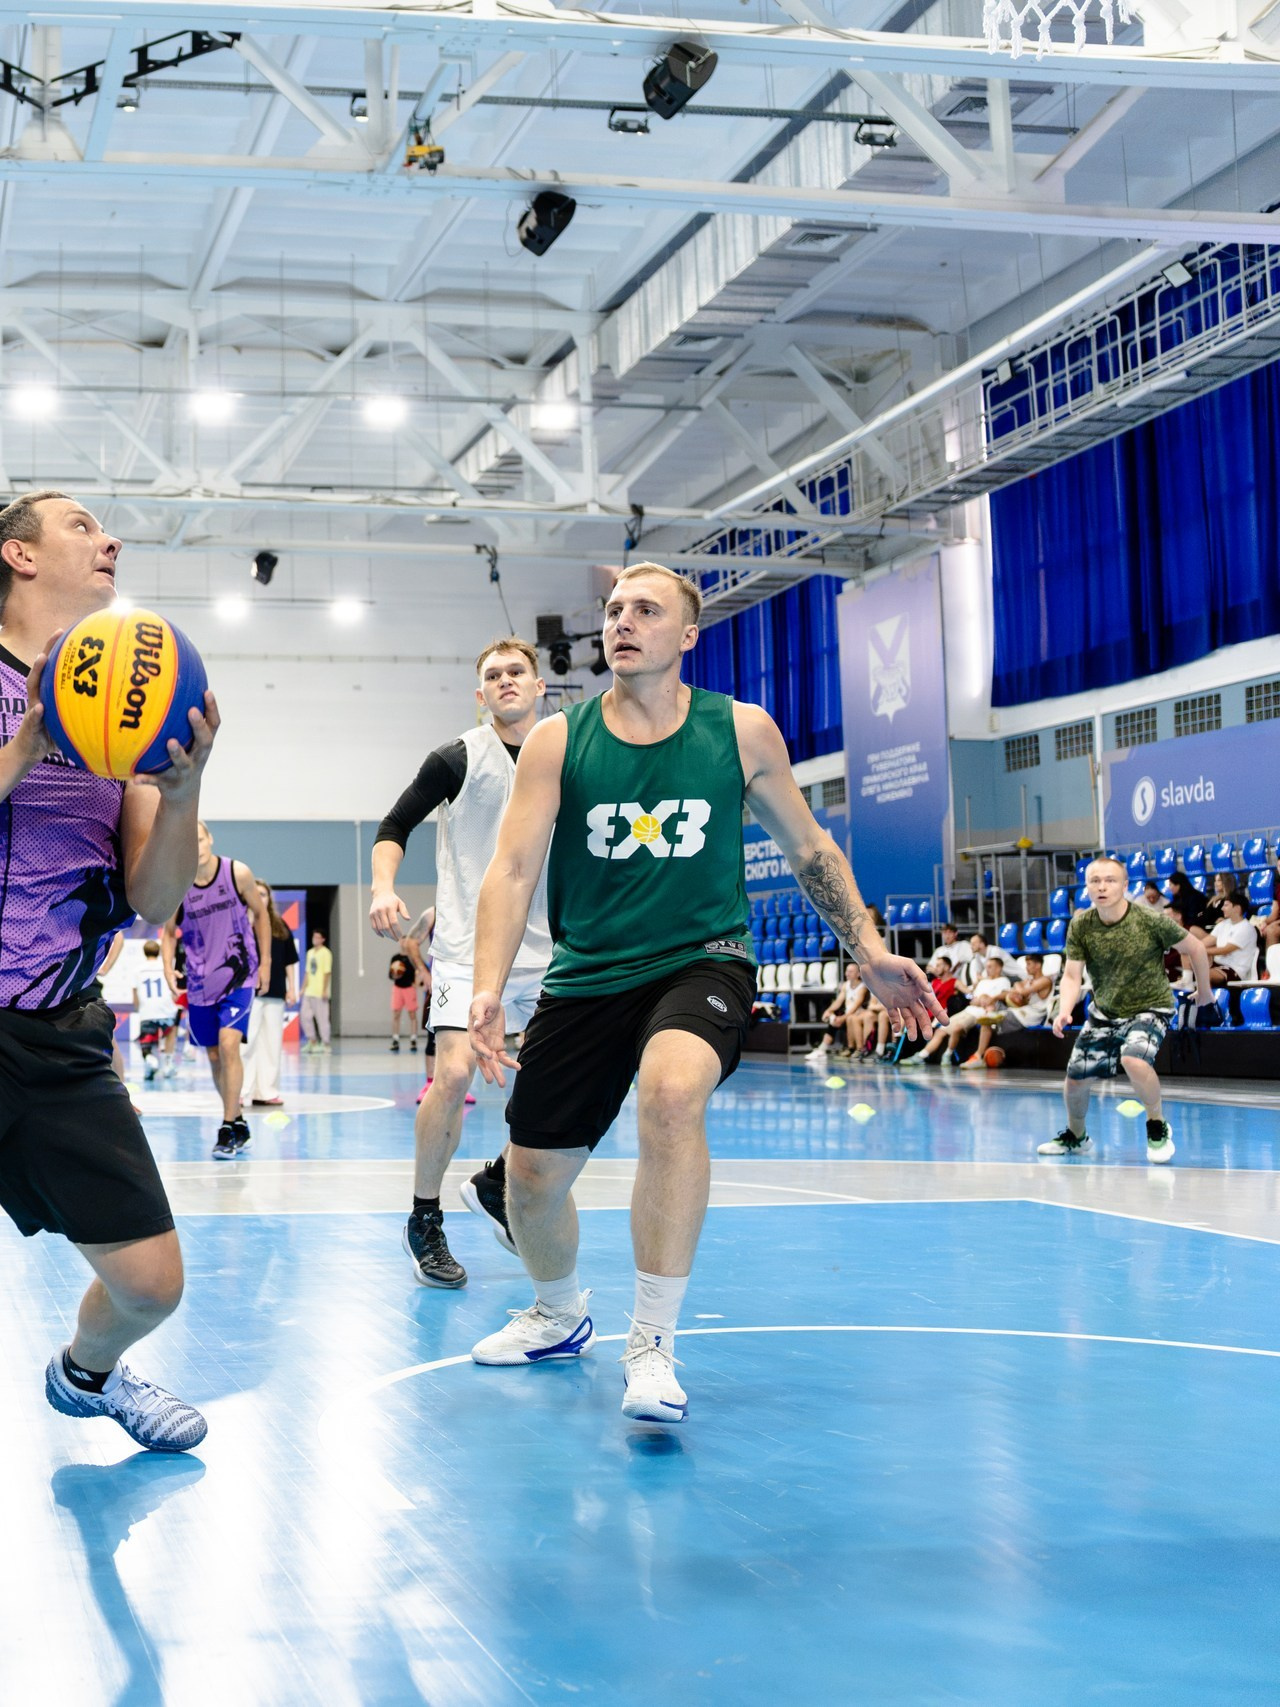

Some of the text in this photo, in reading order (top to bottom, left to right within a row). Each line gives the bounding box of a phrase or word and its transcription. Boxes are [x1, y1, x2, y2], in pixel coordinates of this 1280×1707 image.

[119, 622, 163, 730] Wilson
[1161, 775, 1216, 808] slavda
[744, 839, 784, 861] ЕРСТВ
[744, 858, 779, 881] СКОГО
[142, 977, 162, 998] 11
